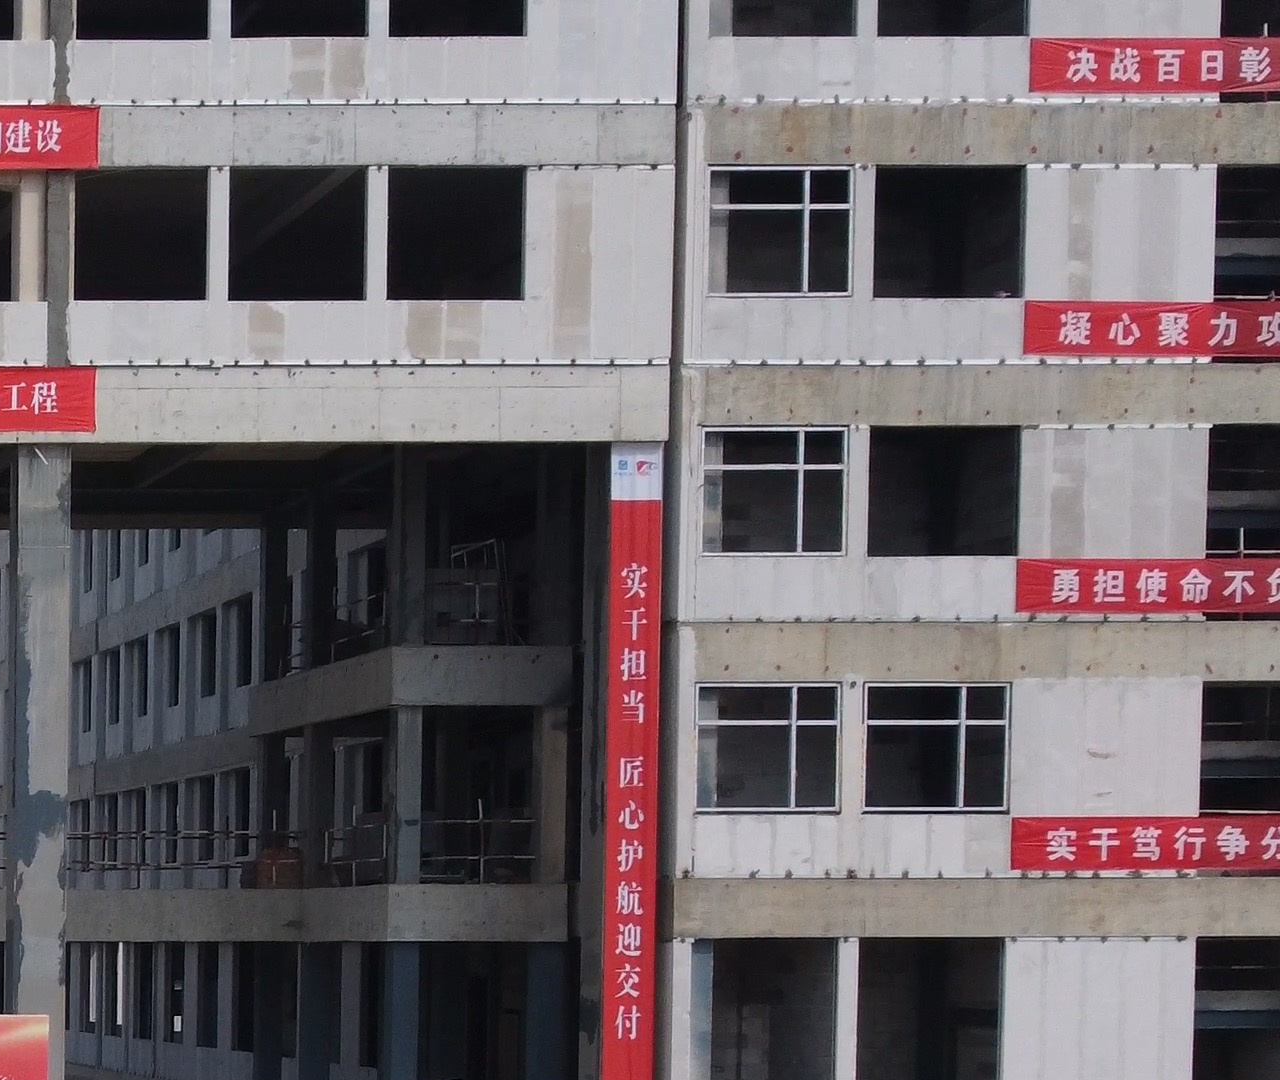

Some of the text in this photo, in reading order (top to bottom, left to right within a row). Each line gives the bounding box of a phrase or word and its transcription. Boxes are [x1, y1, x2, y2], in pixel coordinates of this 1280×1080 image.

[1066, 46, 1273, 83] 决战百日彰
[614, 562, 648, 1041] 实干担当 匠心护航迎交付
